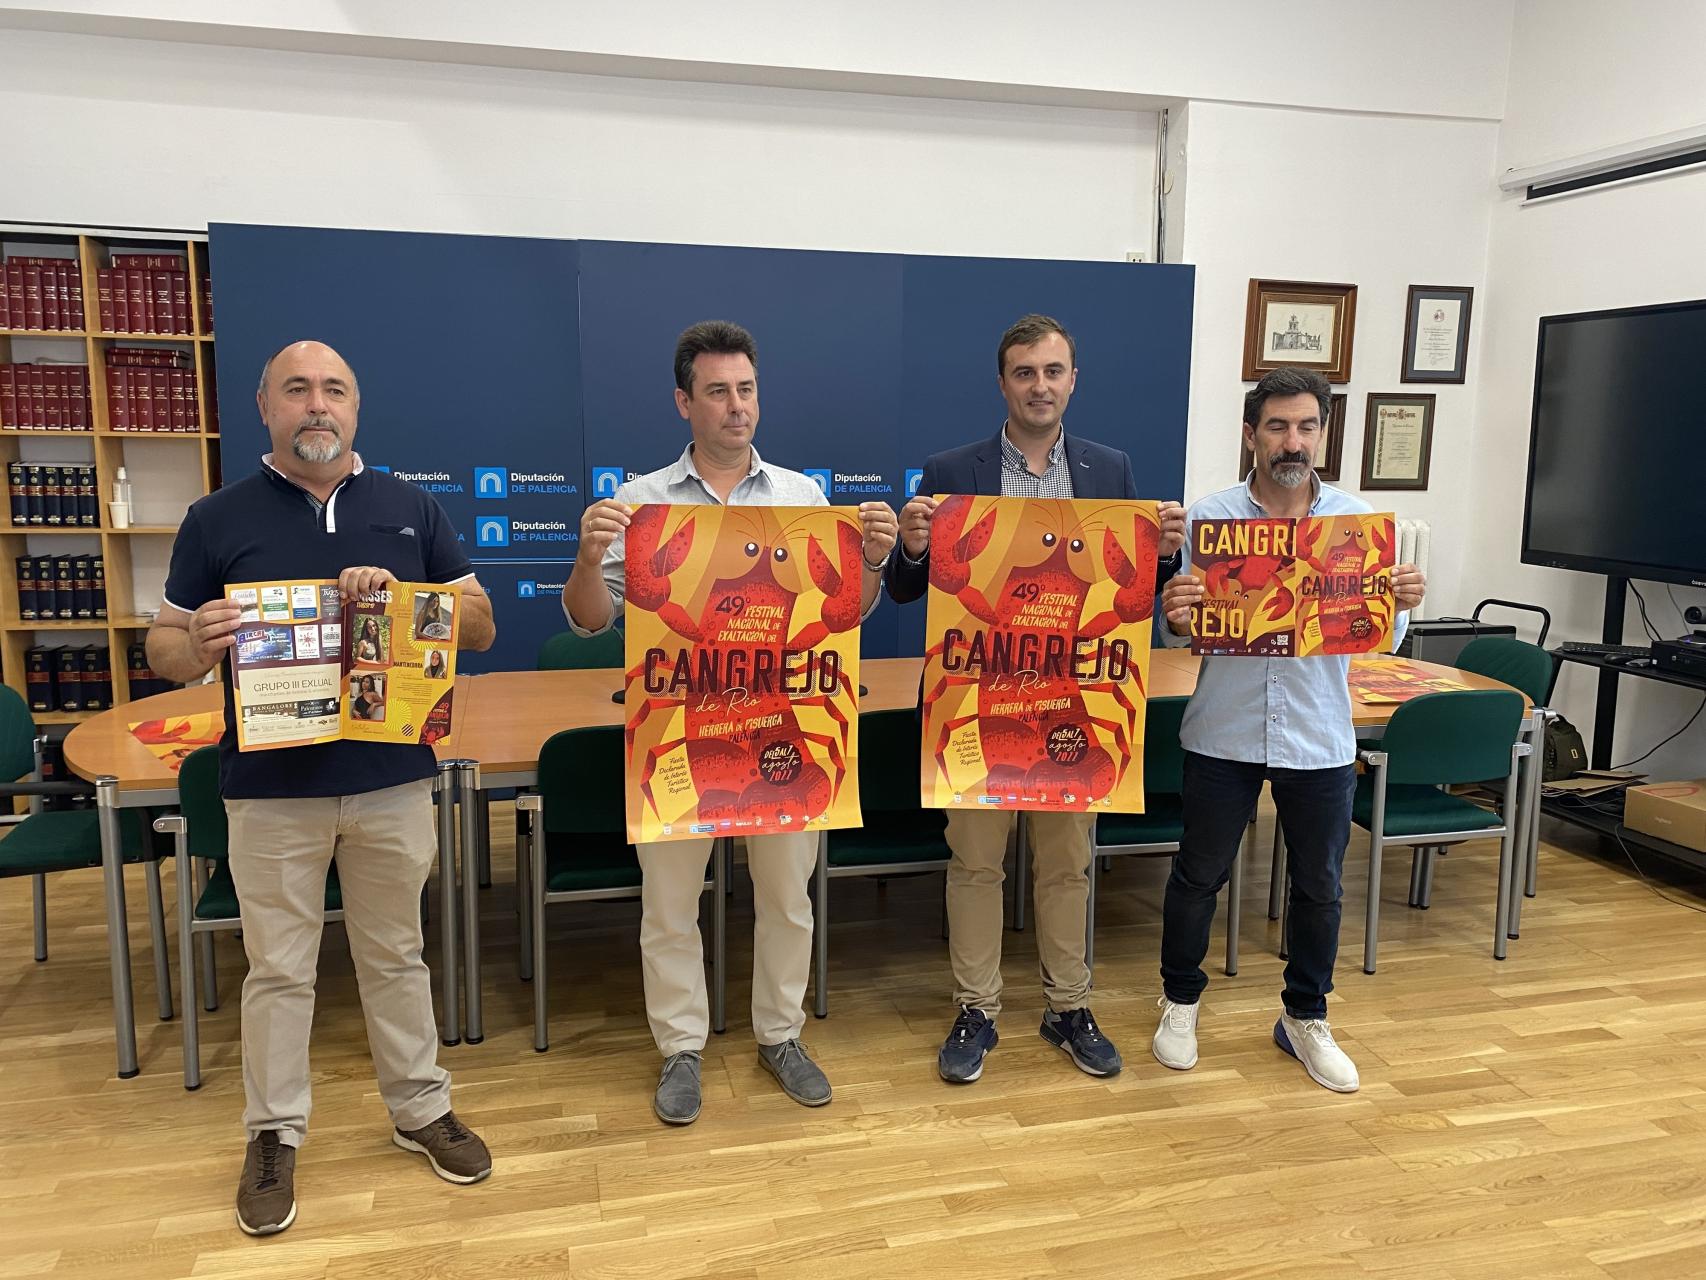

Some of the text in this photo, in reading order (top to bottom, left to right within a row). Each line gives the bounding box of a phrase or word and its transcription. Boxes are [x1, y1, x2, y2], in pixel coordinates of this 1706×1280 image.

[394, 471, 450, 482] Diputación
[510, 472, 565, 483] Diputación
[834, 473, 882, 483] Diputación
[511, 484, 577, 493] DE PALENCIA
[834, 484, 892, 493] DE PALENCIA
[512, 521, 566, 531] Diputación
[513, 533, 578, 541] DE PALENCIA
[1302, 575, 1388, 596] CANGREJO
[360, 590, 393, 603] SSES
[1039, 592, 1078, 606] FESTIVAL
[745, 605, 785, 619] FESTIVAL
[1021, 604, 1064, 617] NACIONAL
[727, 618, 770, 630] NACIONAL
[942, 629, 1130, 684] CANGREJO
[644, 648, 841, 697] CANGREJO
[253, 681, 290, 692] GRUPO
[988, 674, 1012, 692] de
[695, 694, 720, 713] de
[990, 701, 1024, 715] HERRERA
[1034, 697, 1071, 712] PISUERGA
[699, 721, 734, 738] HERRERA
[745, 713, 783, 730] PISUERGA
[1048, 734, 1087, 752] agosto
[761, 752, 800, 773] agosto
